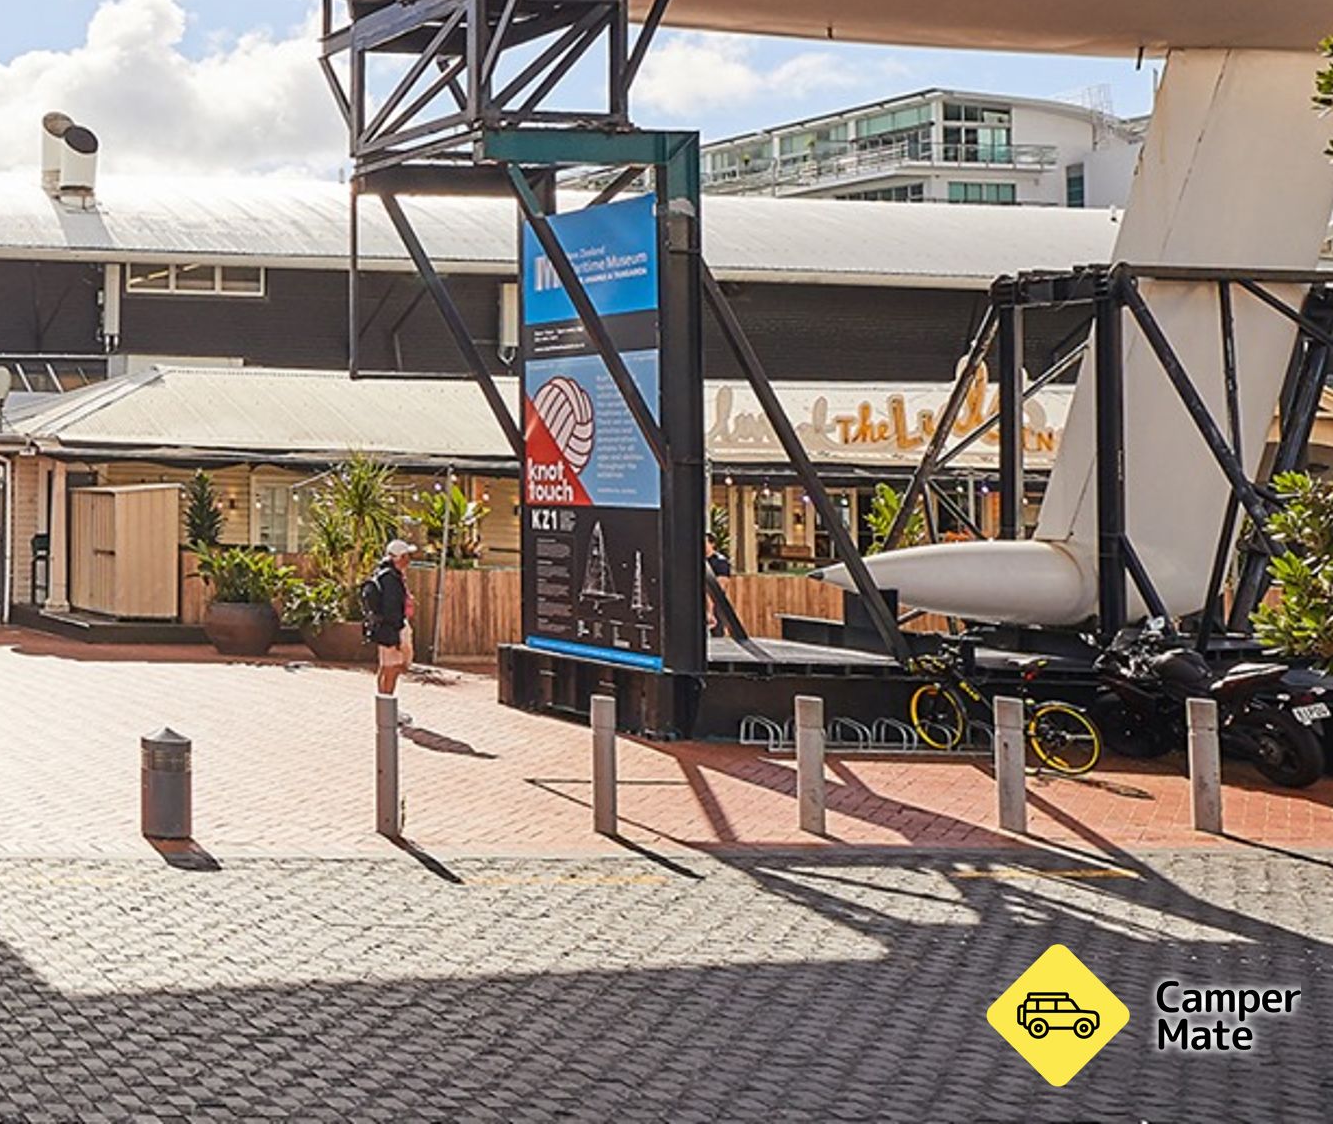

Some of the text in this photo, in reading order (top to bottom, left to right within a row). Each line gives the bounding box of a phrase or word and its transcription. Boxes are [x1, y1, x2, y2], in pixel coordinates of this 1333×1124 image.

[835, 400, 889, 444] The
[528, 457, 565, 481] knot
[529, 478, 573, 502] touch
